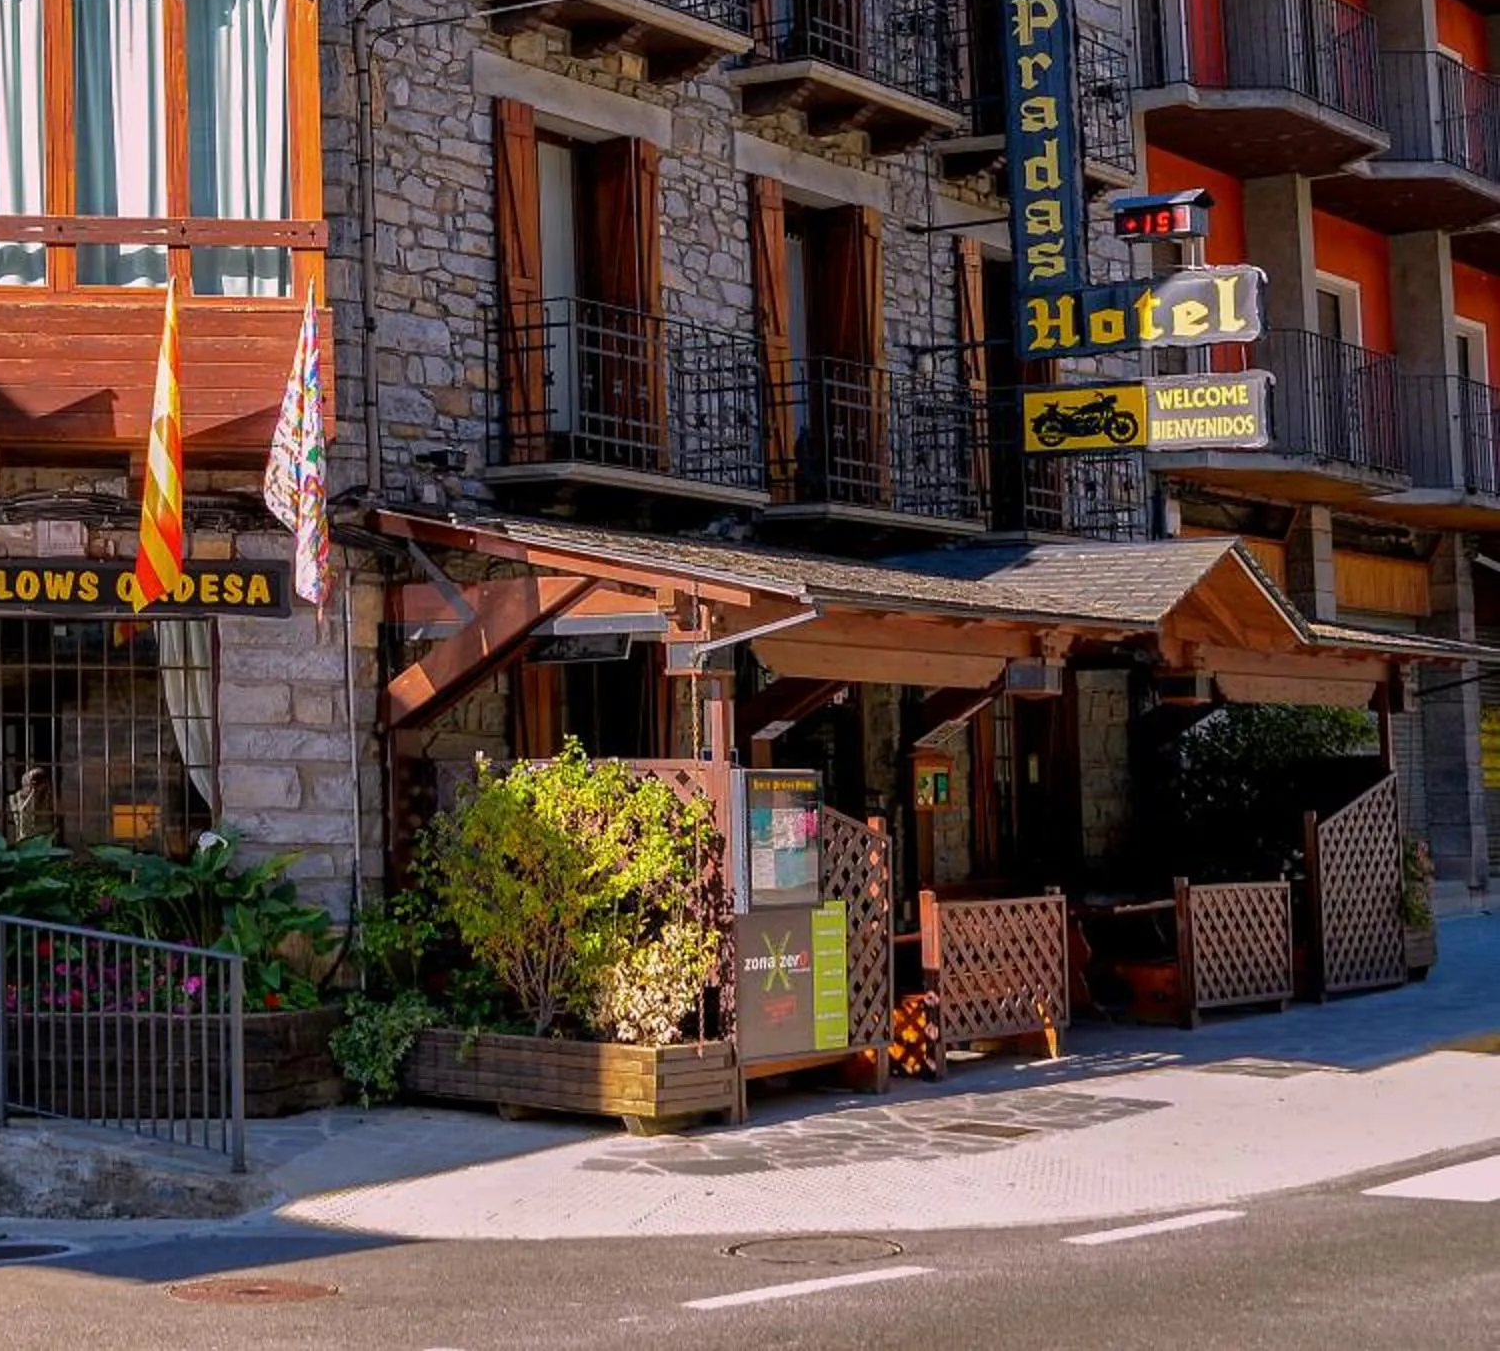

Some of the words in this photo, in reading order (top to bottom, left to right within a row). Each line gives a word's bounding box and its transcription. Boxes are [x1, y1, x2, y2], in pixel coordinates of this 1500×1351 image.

[1027, 275, 1247, 351] Hotel
[1155, 384, 1250, 410] WELCOME
[1151, 414, 1256, 441] BIENVENIDOS
[115, 571, 271, 604] ODESA
[743, 956, 776, 971] zona
